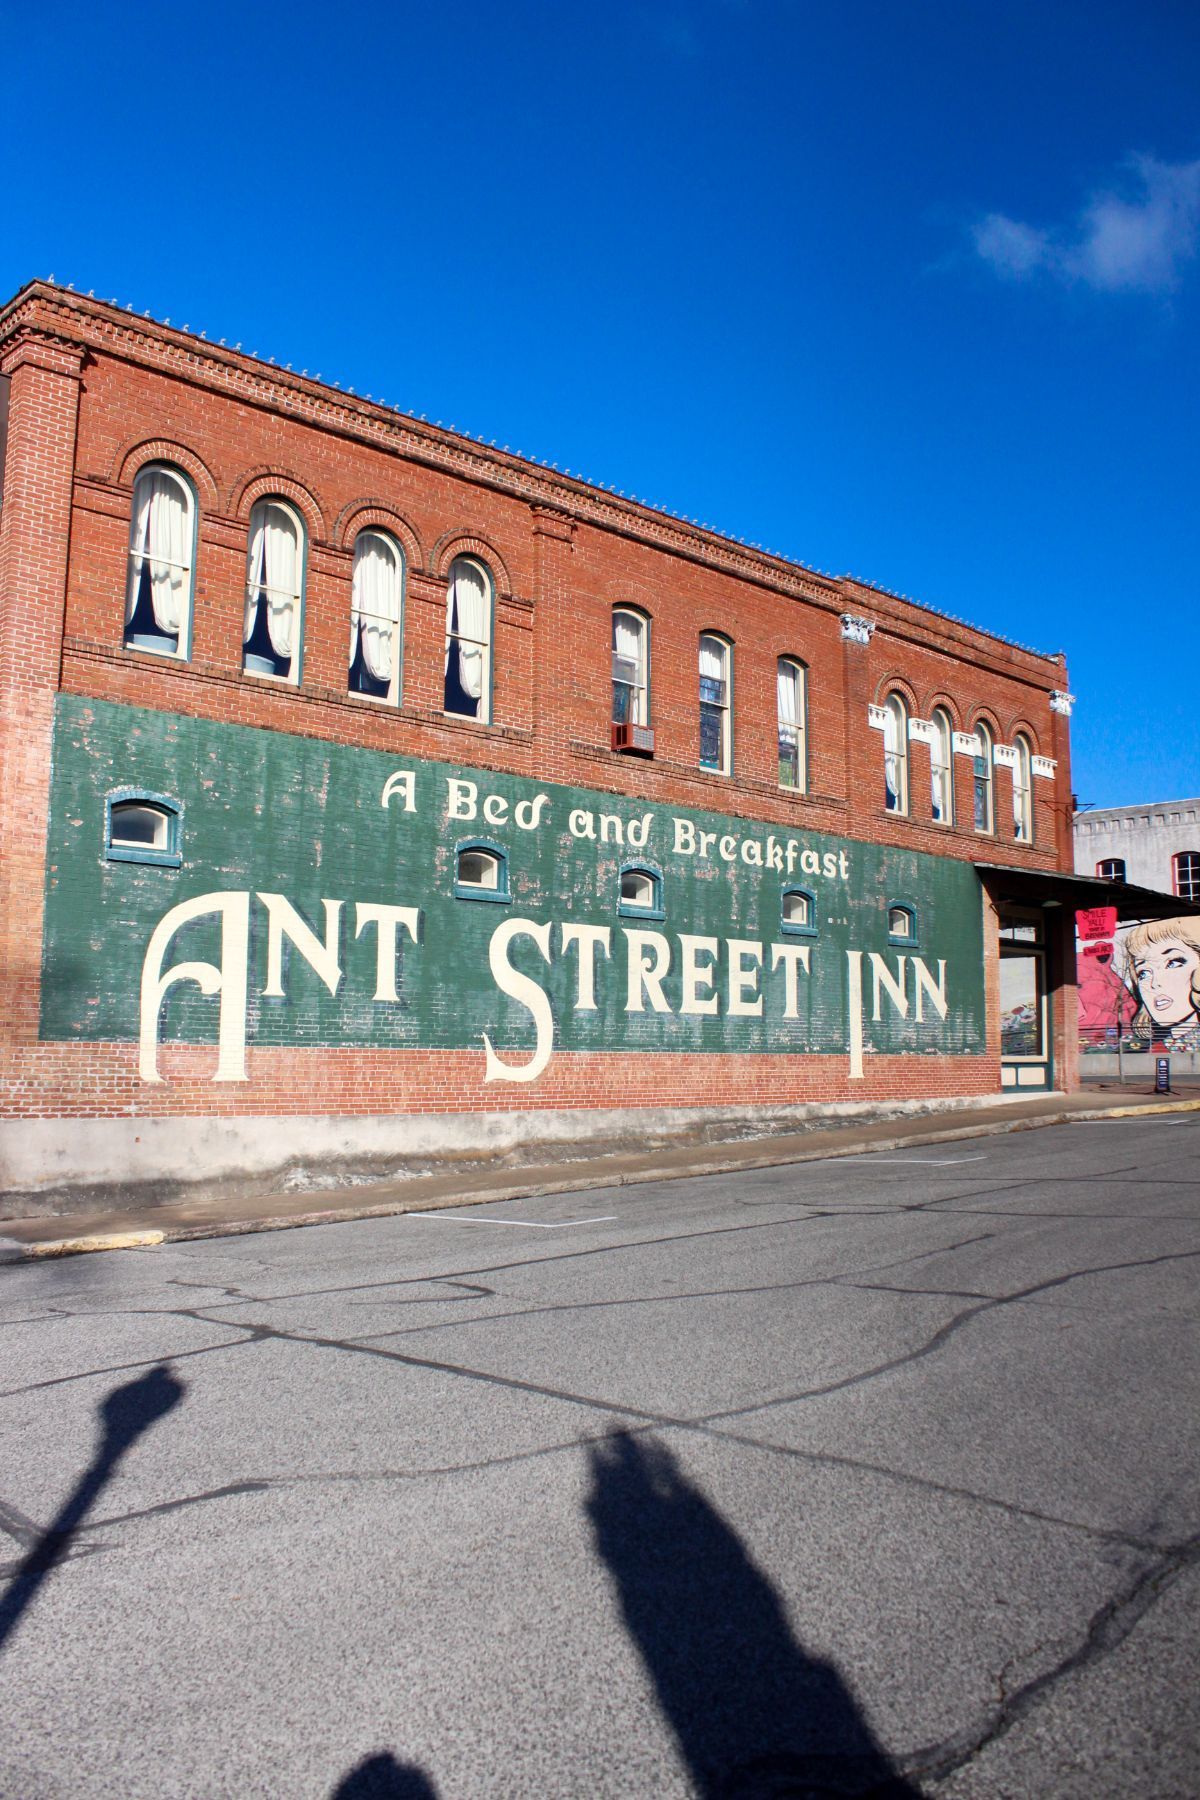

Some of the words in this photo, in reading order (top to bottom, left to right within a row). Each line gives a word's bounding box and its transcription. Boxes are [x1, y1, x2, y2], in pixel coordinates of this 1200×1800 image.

[381, 770, 417, 813] A
[446, 777, 548, 831] Bed
[569, 809, 654, 848] and
[672, 817, 850, 880] Breakfast
[139, 890, 420, 1083] ANT
[481, 917, 811, 1084] STREET
[846, 950, 948, 1079] INN
